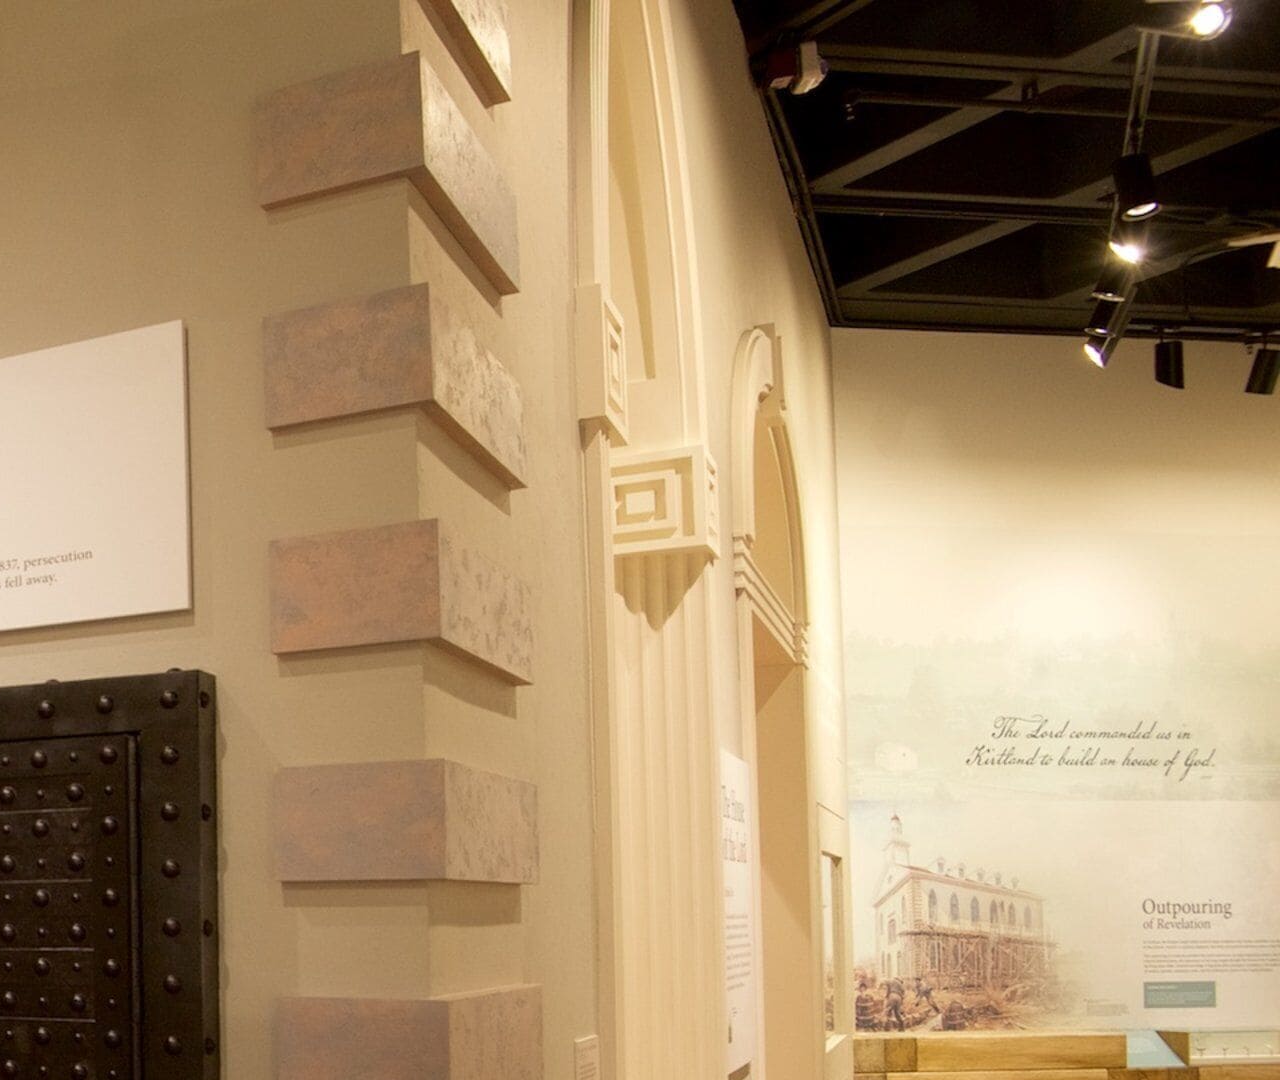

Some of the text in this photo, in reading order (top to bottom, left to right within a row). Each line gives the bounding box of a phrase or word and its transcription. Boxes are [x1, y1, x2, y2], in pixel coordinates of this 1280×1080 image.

[24, 549, 93, 571] persecution
[4, 574, 23, 590] fell
[26, 573, 58, 588] away.
[991, 717, 1192, 740] The Lord commanded us in
[965, 745, 1216, 782] Kirtland to build an house of God.
[1142, 898, 1233, 919] Outpouring
[1143, 918, 1212, 930] of Revelation
